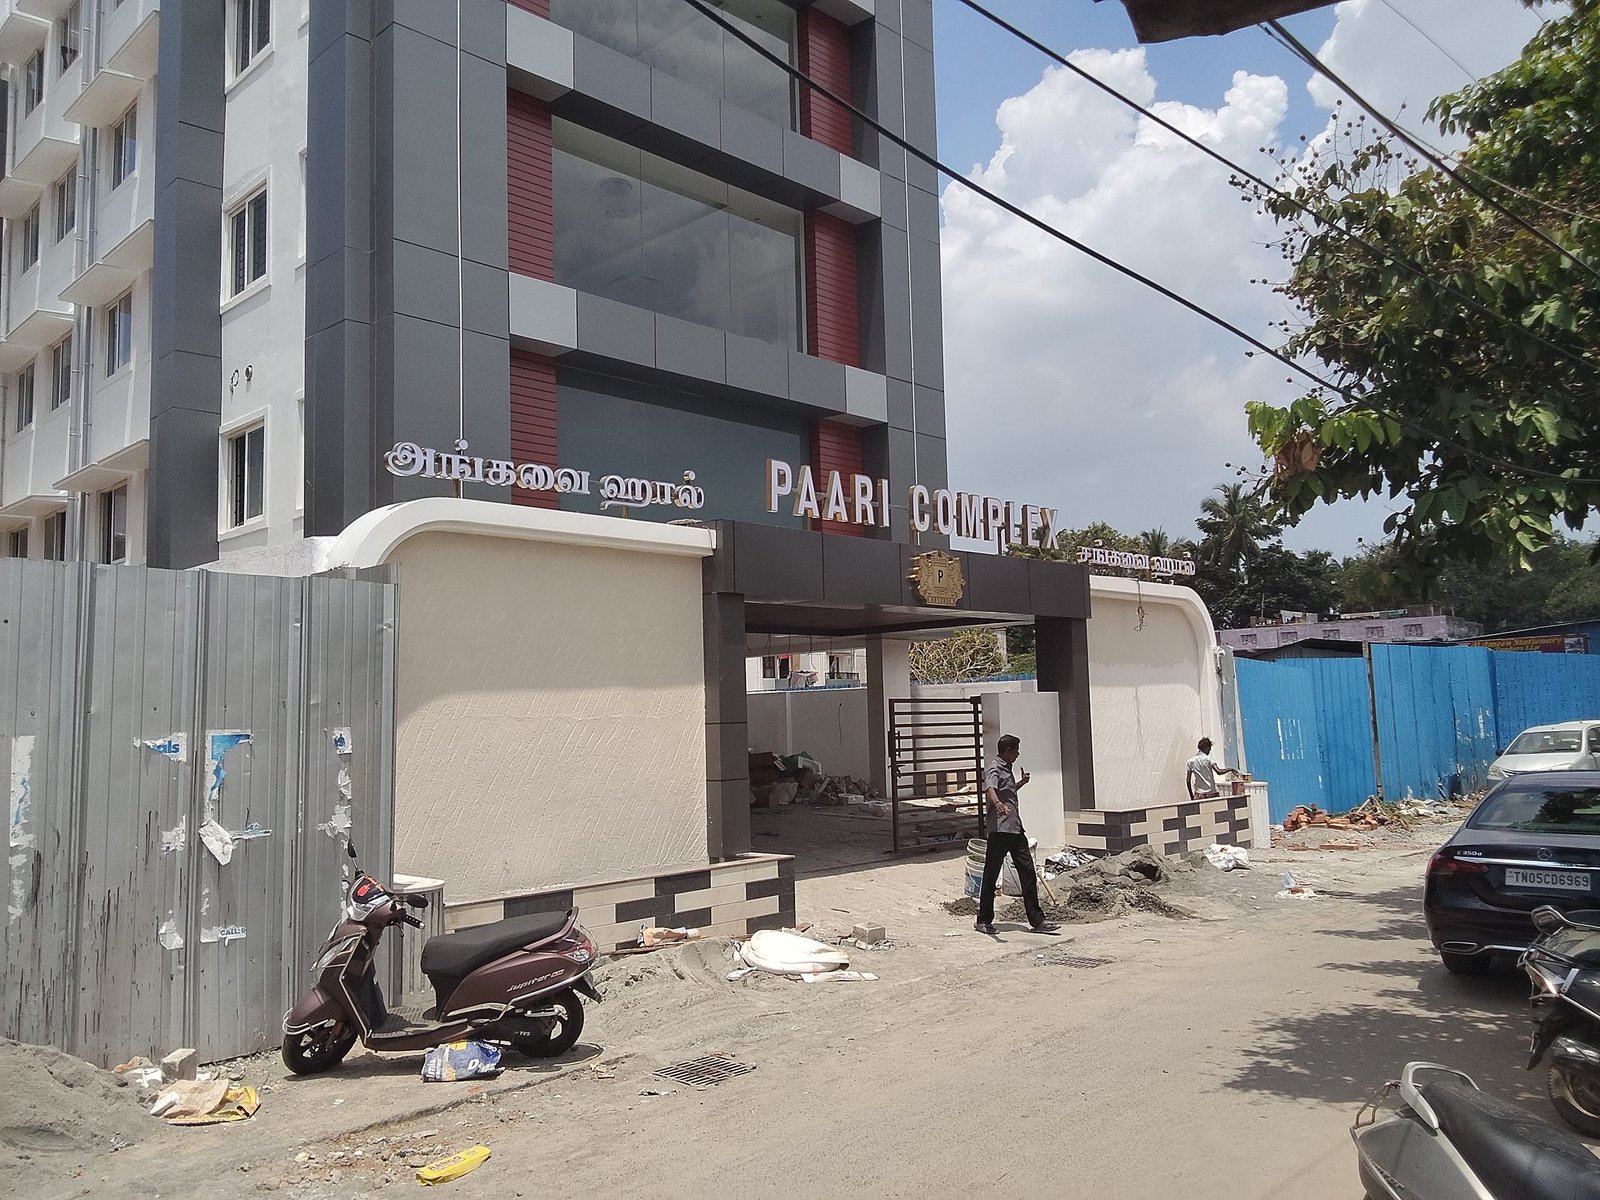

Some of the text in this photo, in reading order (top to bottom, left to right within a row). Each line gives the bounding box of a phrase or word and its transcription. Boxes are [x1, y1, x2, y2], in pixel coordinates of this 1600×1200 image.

[383, 438, 705, 511] அங்கவை ஹால்
[766, 458, 1060, 550] PAARI COMPLEX
[937, 569, 945, 584] P
[1513, 870, 1589, 887] TN05CD6969
